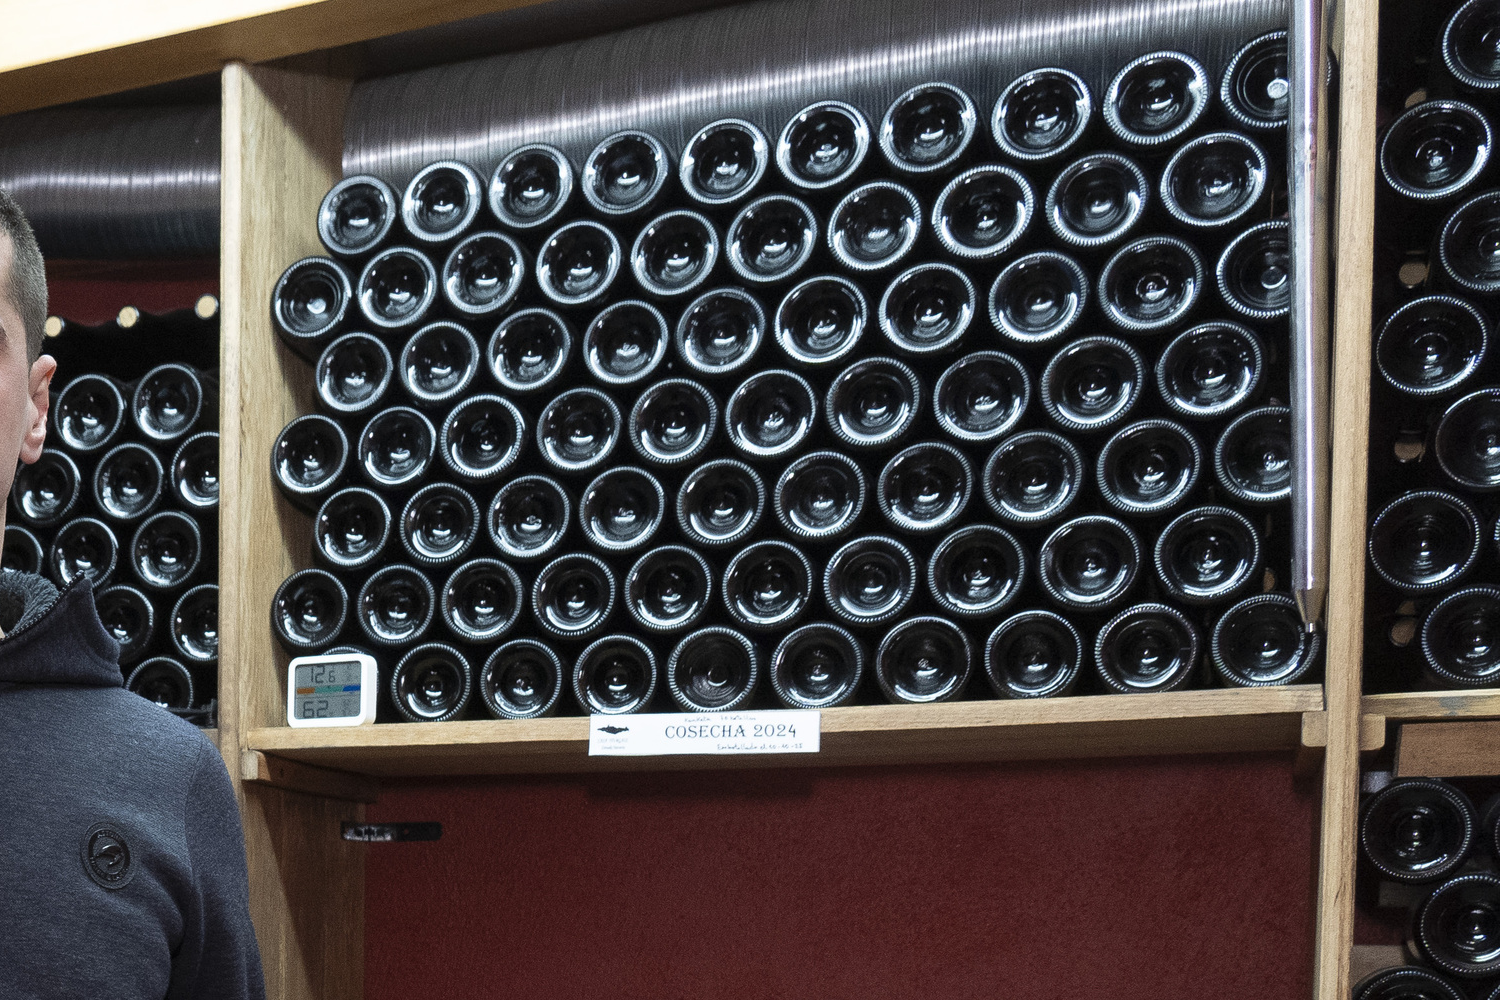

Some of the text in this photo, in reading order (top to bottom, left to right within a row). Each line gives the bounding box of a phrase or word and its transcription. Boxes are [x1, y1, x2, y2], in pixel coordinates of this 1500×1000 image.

[303, 701, 328, 718] 62
[665, 724, 796, 738] COSECHA 2024
